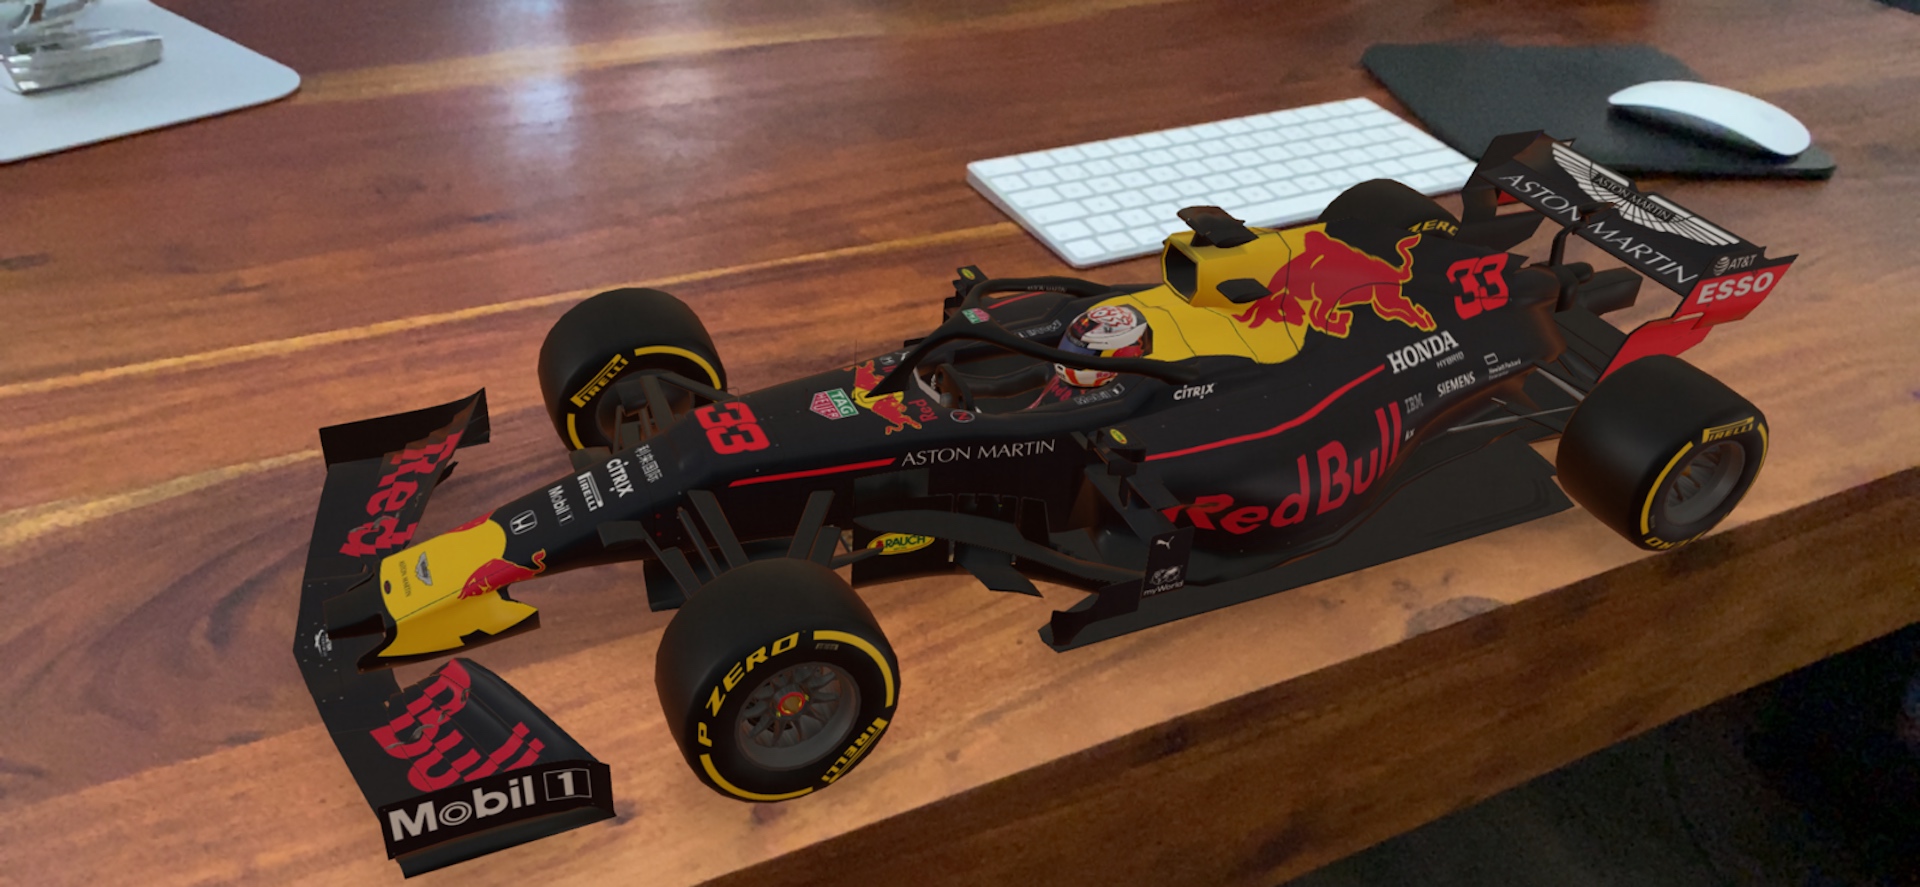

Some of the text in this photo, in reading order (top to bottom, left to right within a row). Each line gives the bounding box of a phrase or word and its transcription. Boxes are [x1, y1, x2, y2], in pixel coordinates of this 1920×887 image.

[1595, 176, 1672, 221] ASTON MARTIN
[1498, 174, 1698, 284] ASTON MARTIN
[1727, 253, 1758, 271] AT&T
[1445, 252, 1510, 320] 33
[1696, 271, 1774, 305] ESSO
[1387, 330, 1459, 374] HONDA
[1436, 351, 1465, 369] HYBRID
[570, 353, 629, 408] PIRELLI
[1436, 370, 1477, 398] SIEMENS
[812, 393, 839, 419] HEUER
[831, 390, 852, 415] TAG
[907, 399, 939, 422] Red
[1404, 392, 1424, 414] IBM
[694, 401, 771, 455] 33
[1702, 416, 1755, 444] PIRELLI
[901, 439, 1056, 467] ASTON MARTIN
[1162, 401, 1403, 535] Red Bull
[339, 429, 464, 558] Red
[548, 485, 571, 516] Mobil
[577, 471, 604, 512] PIRELLI
[885, 534, 926, 549] RAUCH
[1143, 579, 1184, 596] myWorld
[697, 631, 800, 747] P ZERO
[369, 657, 546, 793] Bull
[821, 716, 889, 784] PIRELLI
[388, 774, 537, 842] Mobil
